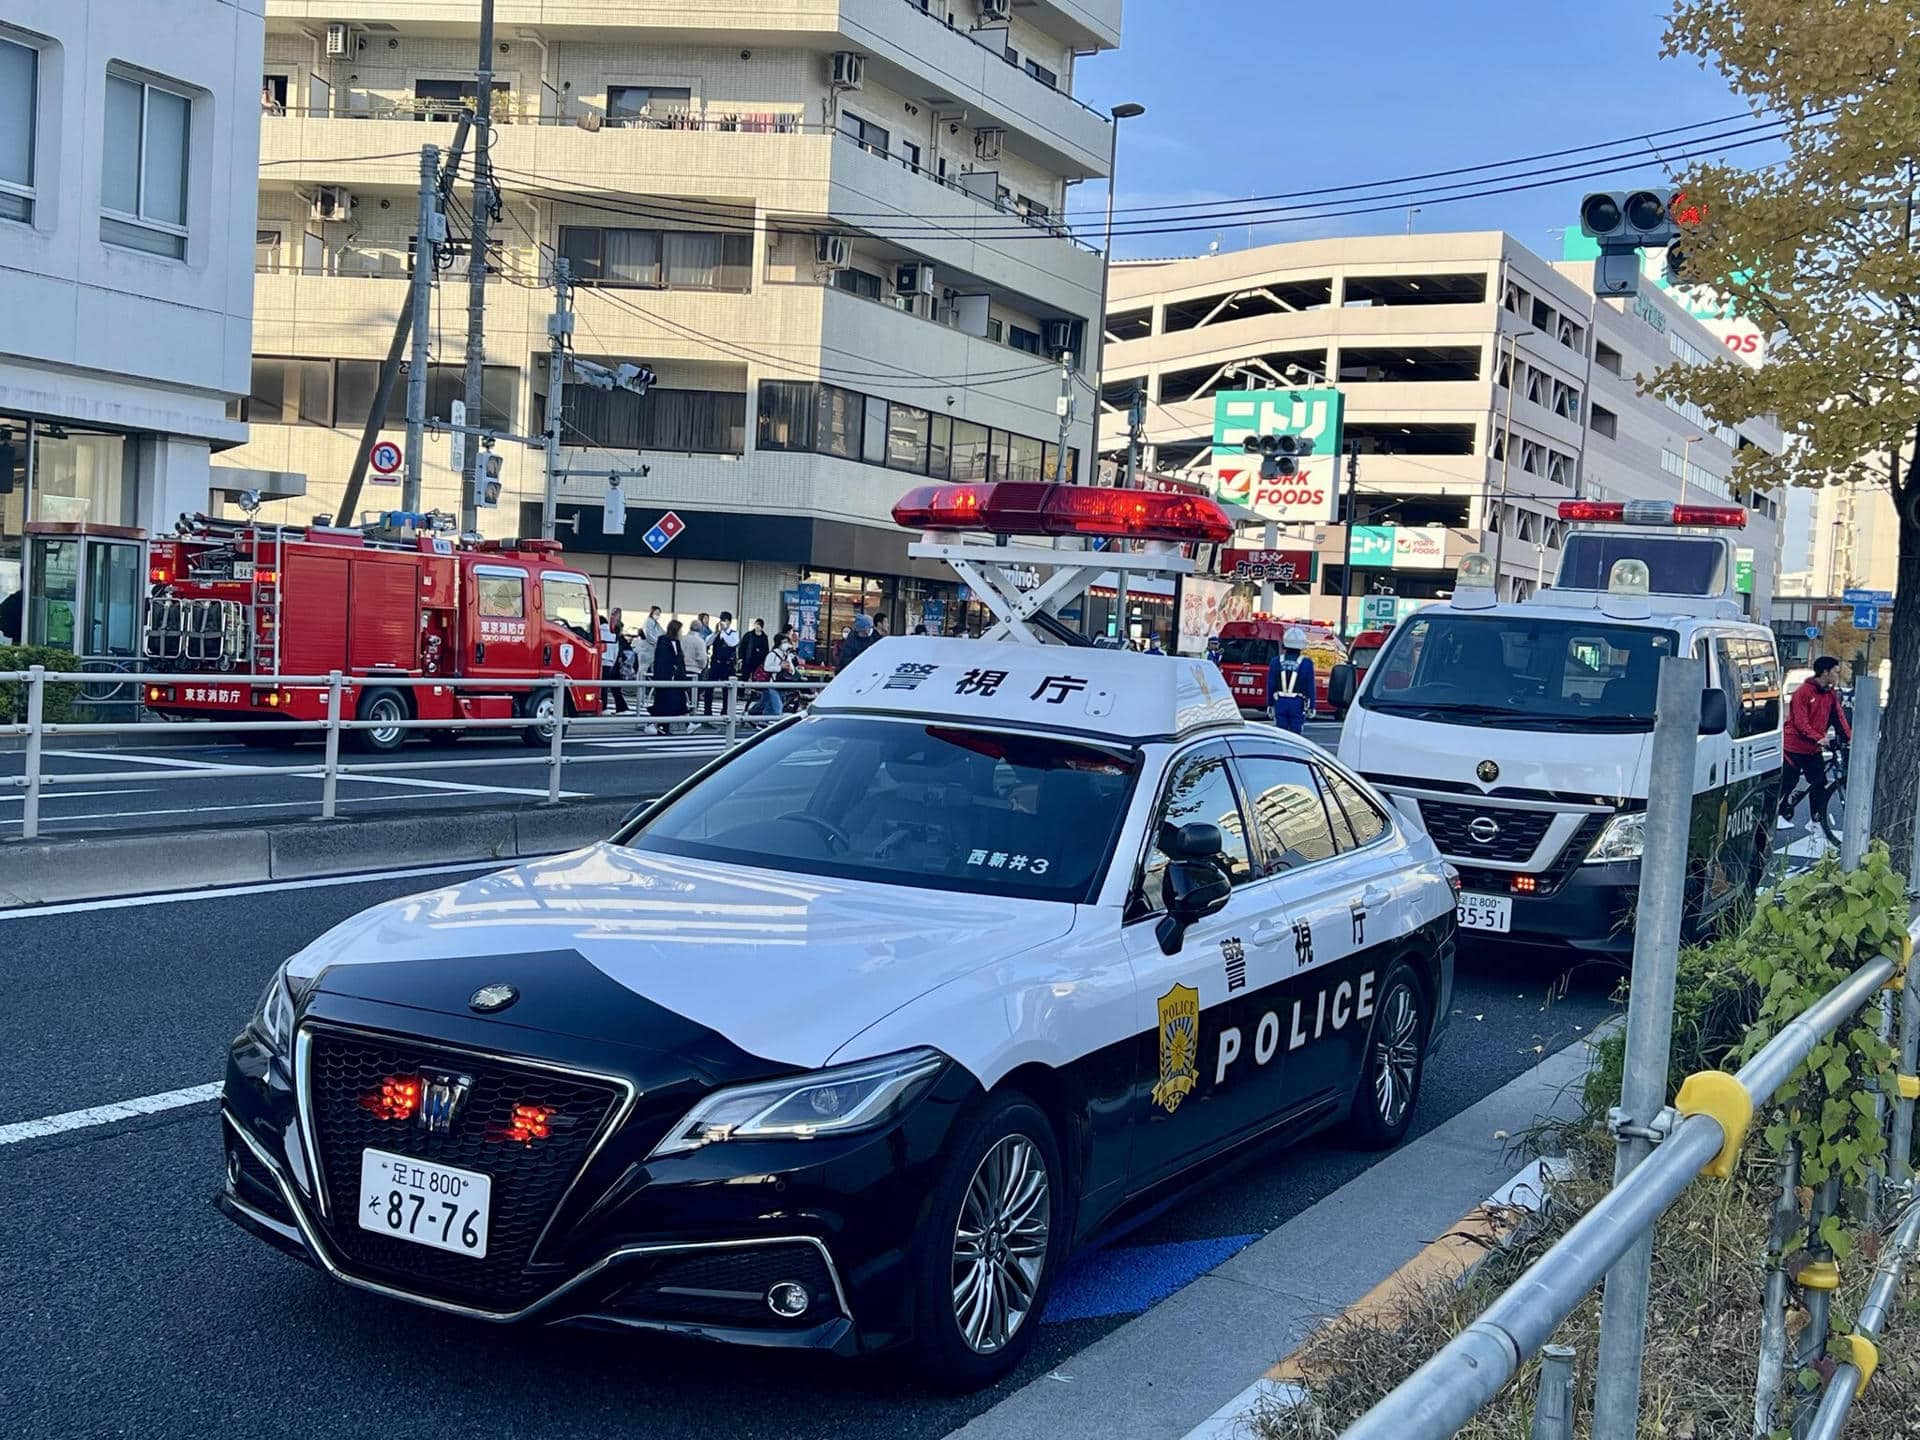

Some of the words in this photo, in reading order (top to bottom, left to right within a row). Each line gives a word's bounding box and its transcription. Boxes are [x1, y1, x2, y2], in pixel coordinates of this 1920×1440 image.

[391, 162, 425, 190] 足立
[429, 172, 461, 197] 800
[387, 190, 481, 248] 87-76
[1223, 400, 1328, 445] ニトリ
[1255, 489, 1325, 505] FOODS
[1350, 535, 1392, 554] ニトリ
[1000, 563, 1040, 589] mino's
[1378, 600, 1392, 615] P
[184, 688, 241, 703] 東京消防庁
[882, 662, 1089, 704] 警視庁
[1479, 897, 1497, 908] 800
[1219, 899, 1366, 993] 警視庁
[1162, 1000, 1195, 1024] POLICE
[1215, 971, 1375, 1085] POLICE
